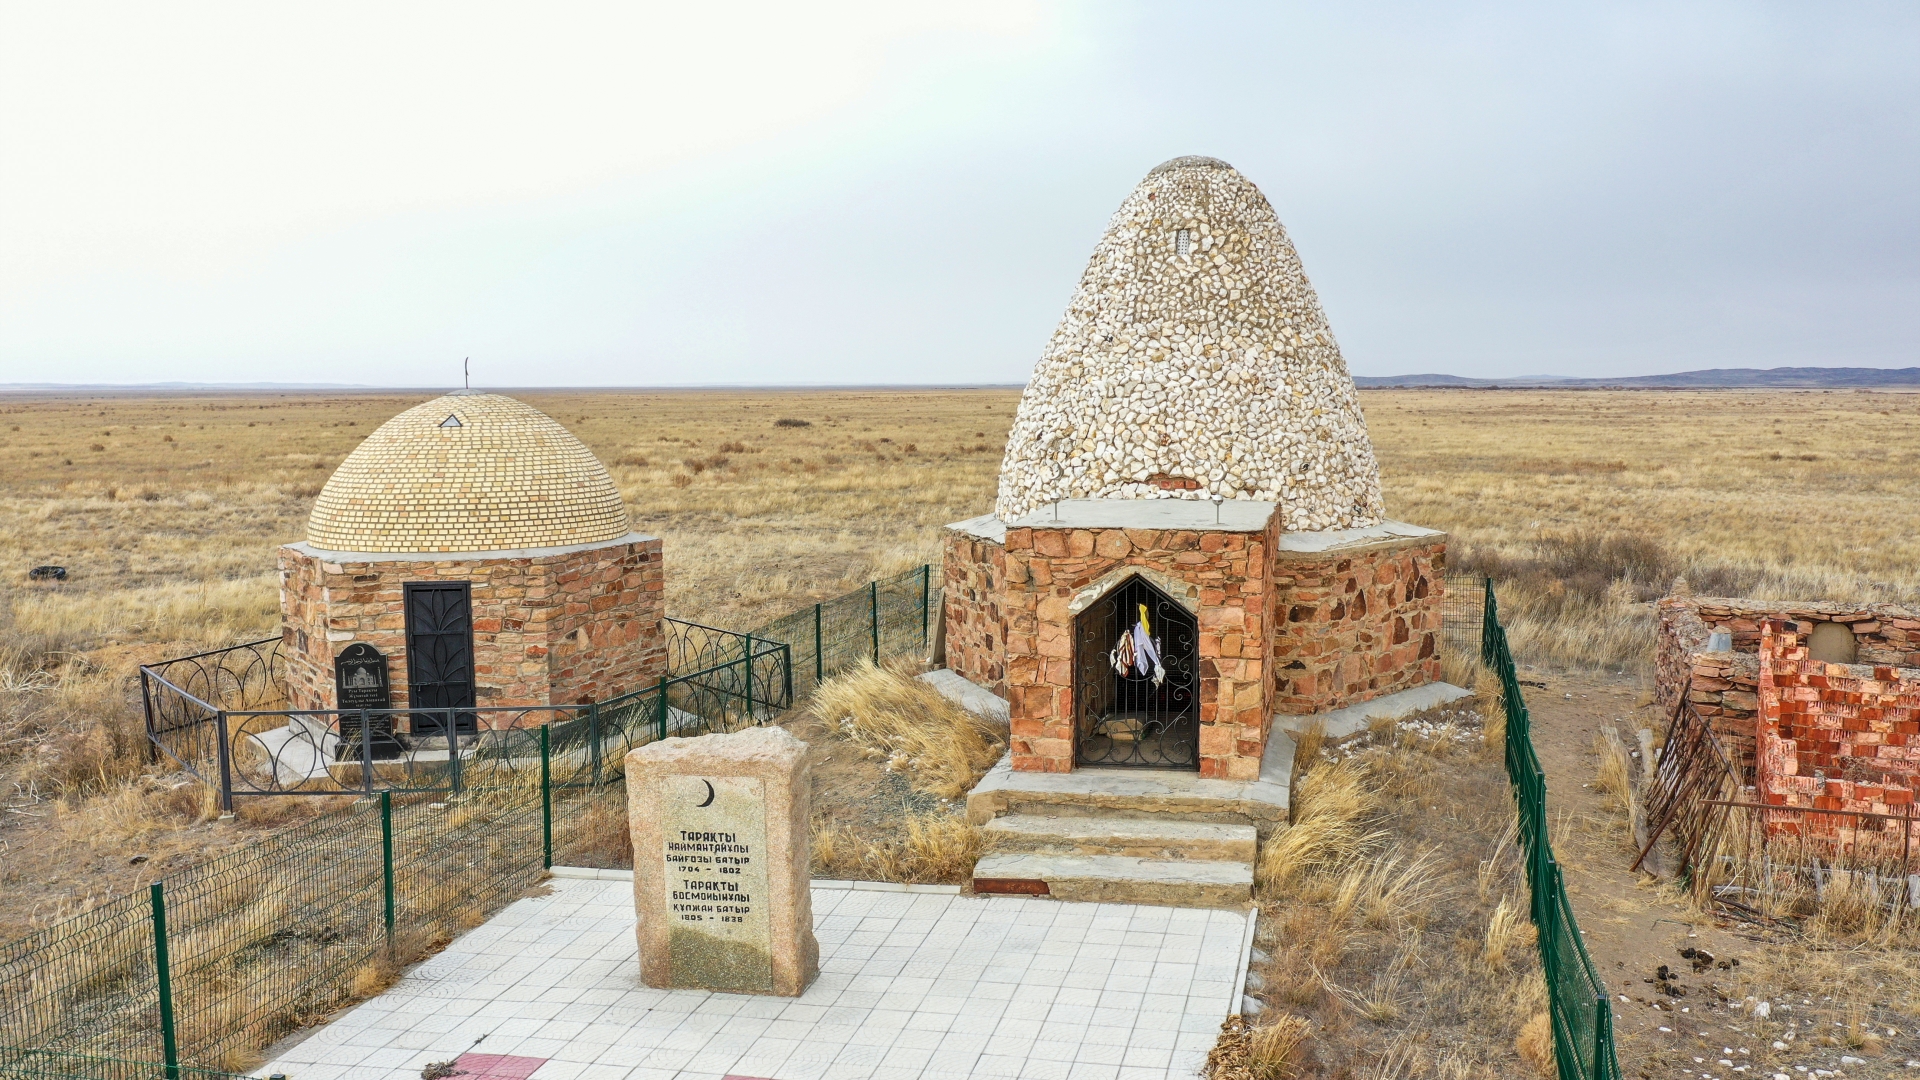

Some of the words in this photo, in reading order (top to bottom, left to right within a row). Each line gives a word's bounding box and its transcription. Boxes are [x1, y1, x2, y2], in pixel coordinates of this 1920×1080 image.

[680, 831, 736, 843] ТАРАҚТЫ
[666, 854, 712, 863] БАЙҒОЗЫ
[715, 856, 750, 865] БАТЫР
[683, 879, 739, 892] ТАРАҚТЫ
[716, 905, 750, 914] БАТЫР
